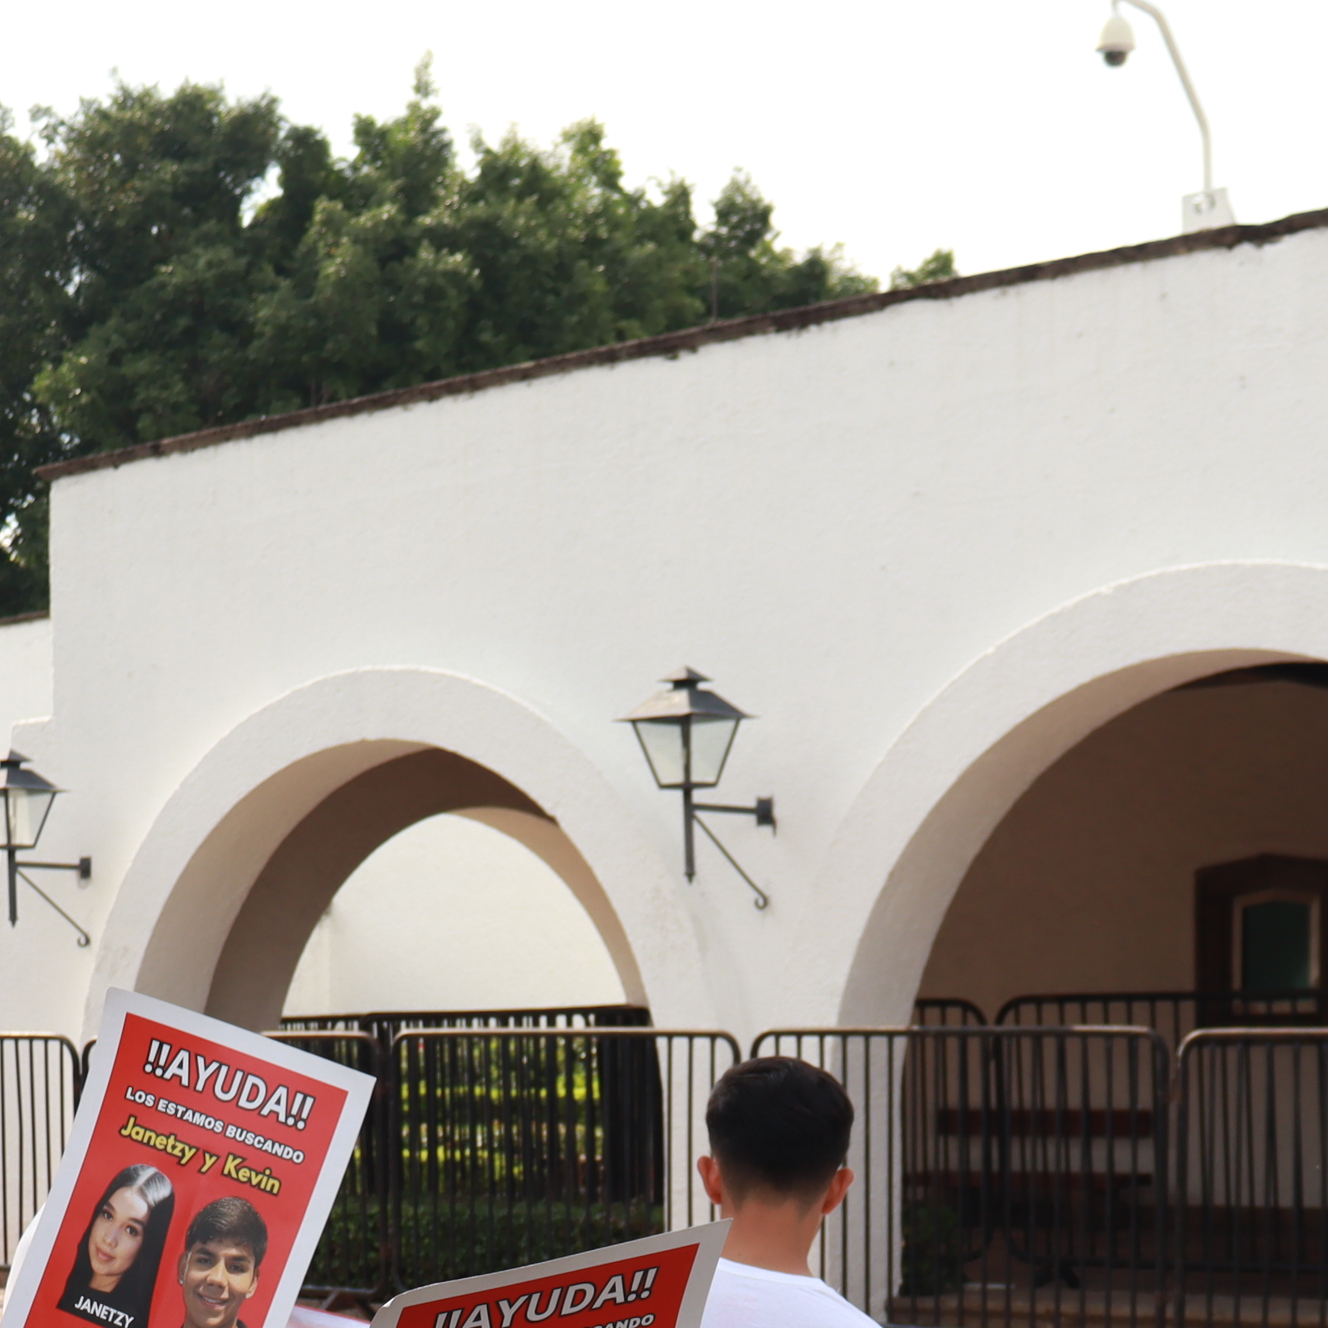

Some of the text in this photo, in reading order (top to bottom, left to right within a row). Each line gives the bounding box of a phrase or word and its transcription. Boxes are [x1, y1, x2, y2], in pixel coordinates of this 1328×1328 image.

[144, 1038, 315, 1130] !!AYUDA!!
[120, 1116, 281, 1194] Janetzy y Kevin
[125, 1087, 304, 1163] LOS ESTAMOS BUSCANDO
[74, 1295, 135, 1328] JANETZY
